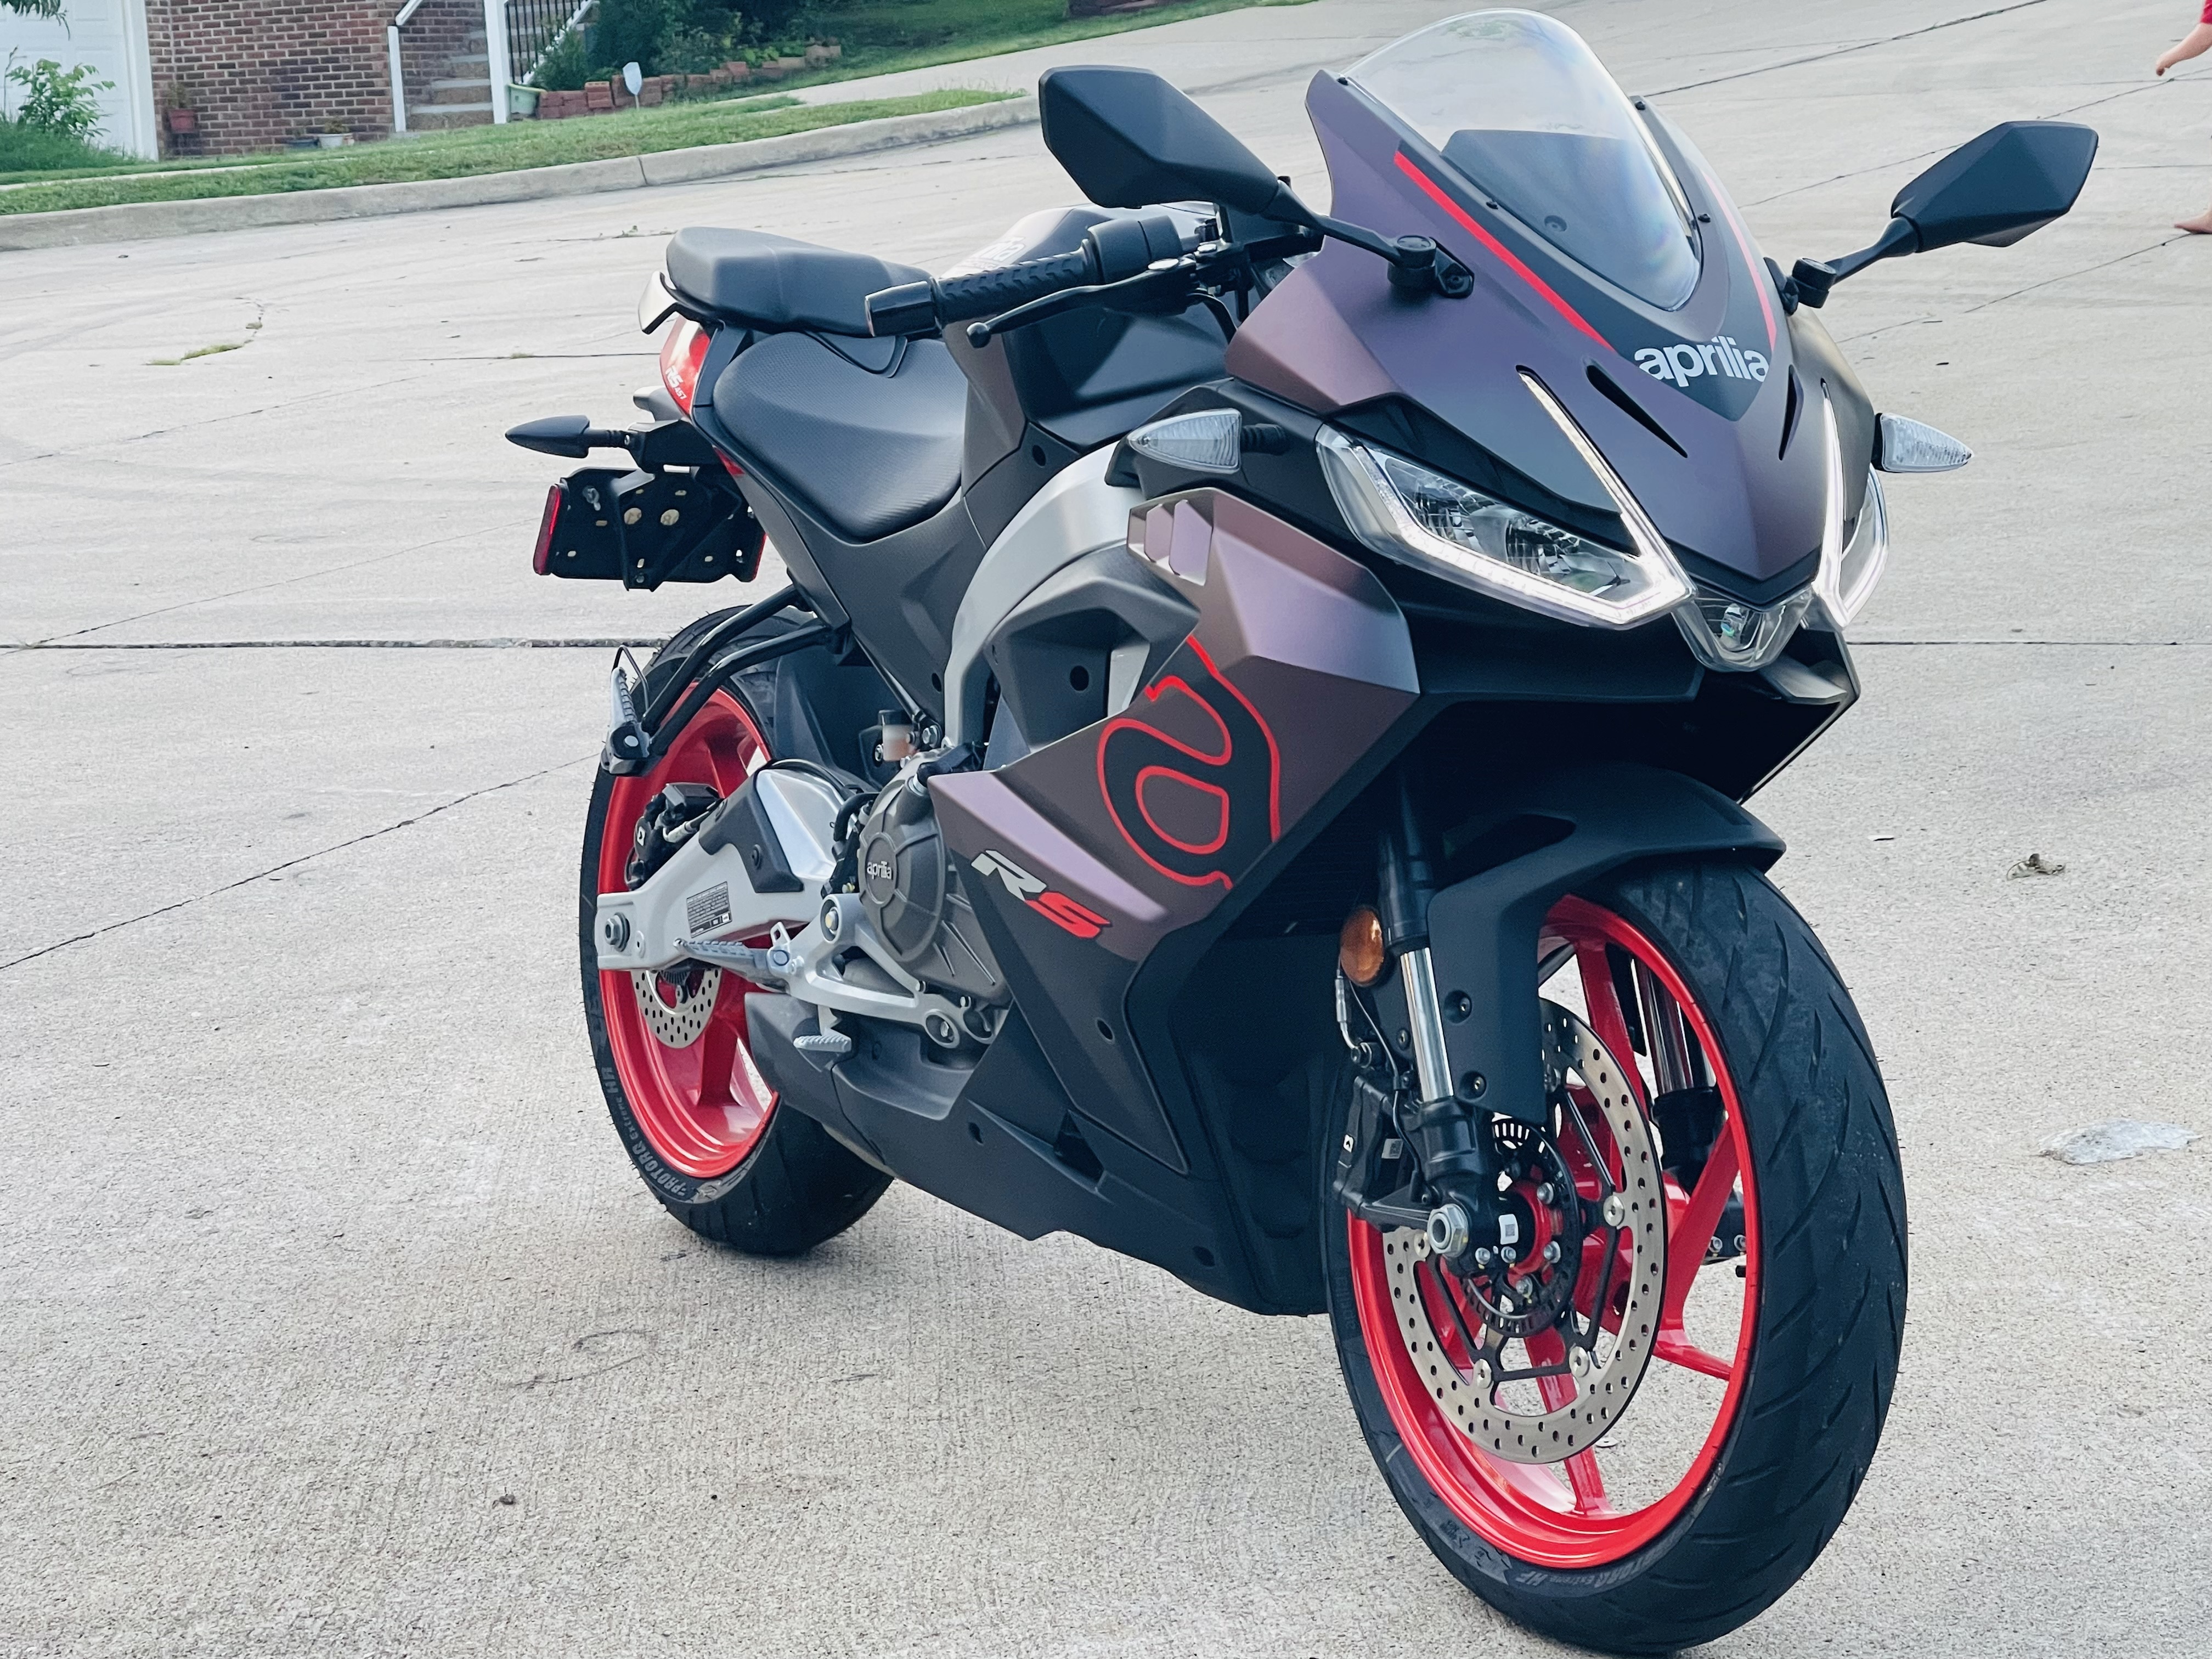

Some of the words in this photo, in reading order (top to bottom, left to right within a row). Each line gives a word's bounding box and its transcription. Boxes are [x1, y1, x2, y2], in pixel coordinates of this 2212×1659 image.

[665, 365, 684, 388] RS
[1634, 335, 1769, 387] aprilia
[867, 860, 892, 880] aprilia
[971, 850, 1110, 939] RS
[632, 1141, 686, 1195] PROTORQ
